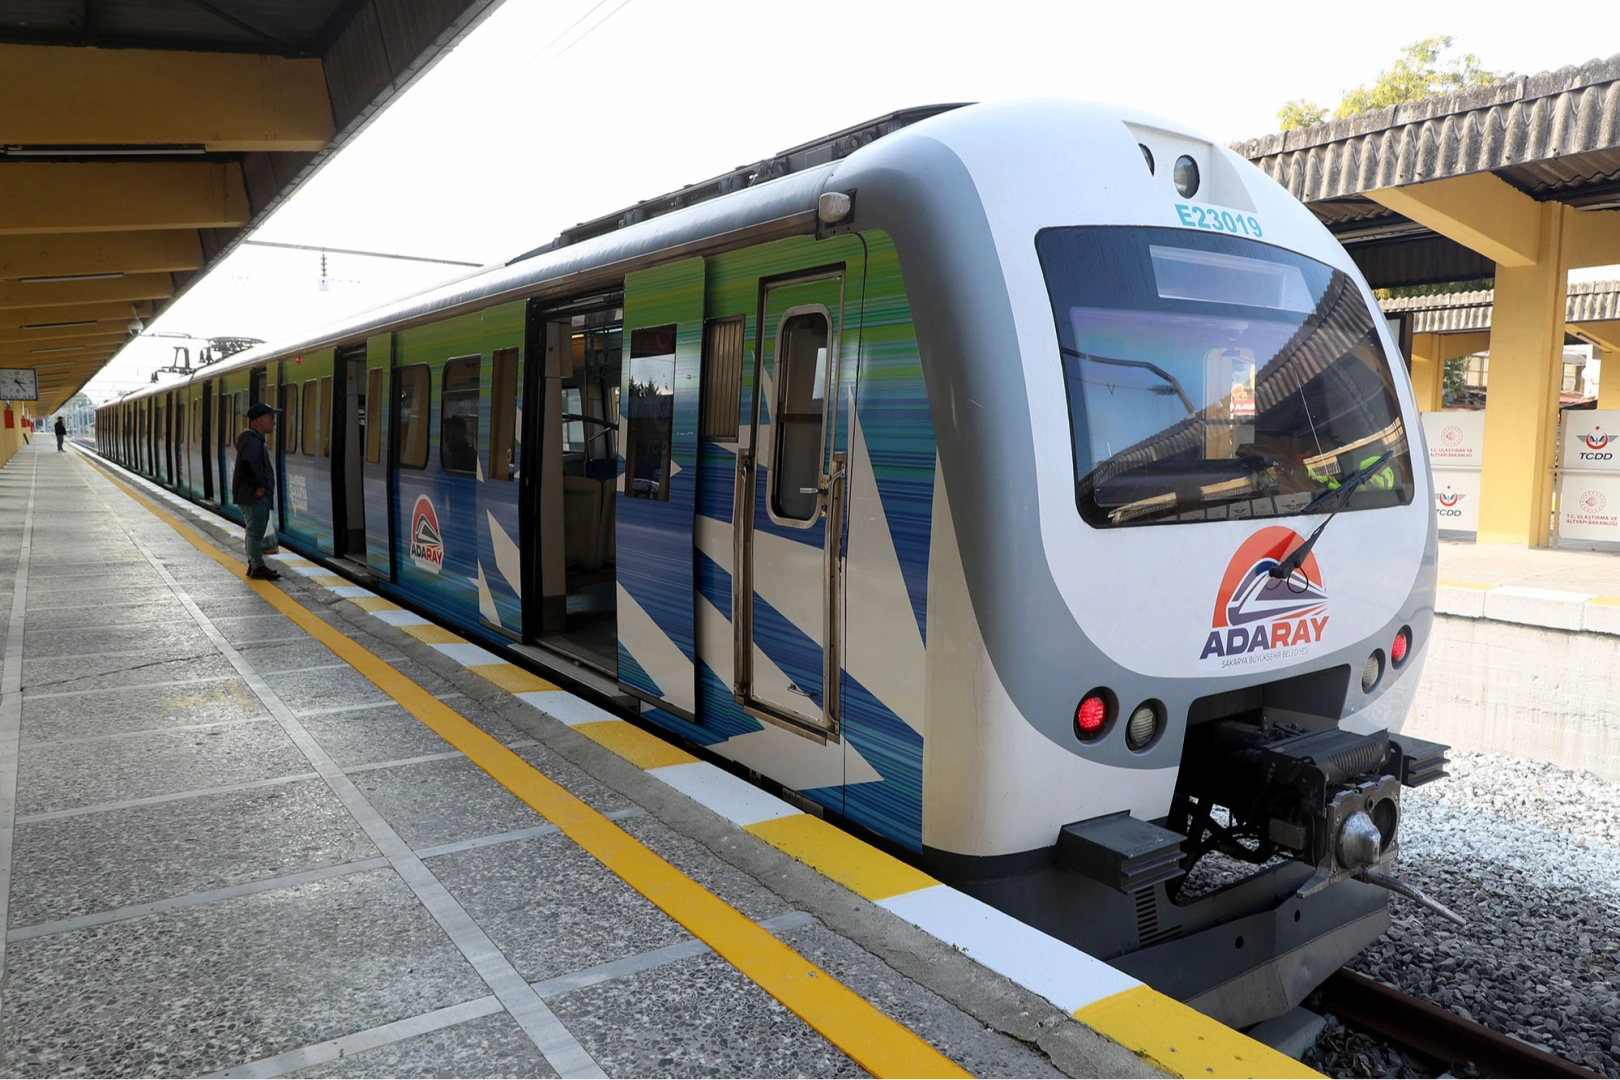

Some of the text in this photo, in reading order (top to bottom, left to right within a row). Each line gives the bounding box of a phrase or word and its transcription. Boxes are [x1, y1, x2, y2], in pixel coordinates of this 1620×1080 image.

[1174, 203, 1263, 238] E23019
[1580, 452, 1613, 460] TCDD
[411, 544, 443, 565] ADARAY
[1200, 616, 1330, 660] ADARAY
[1222, 657, 1248, 668] SAKARYA
